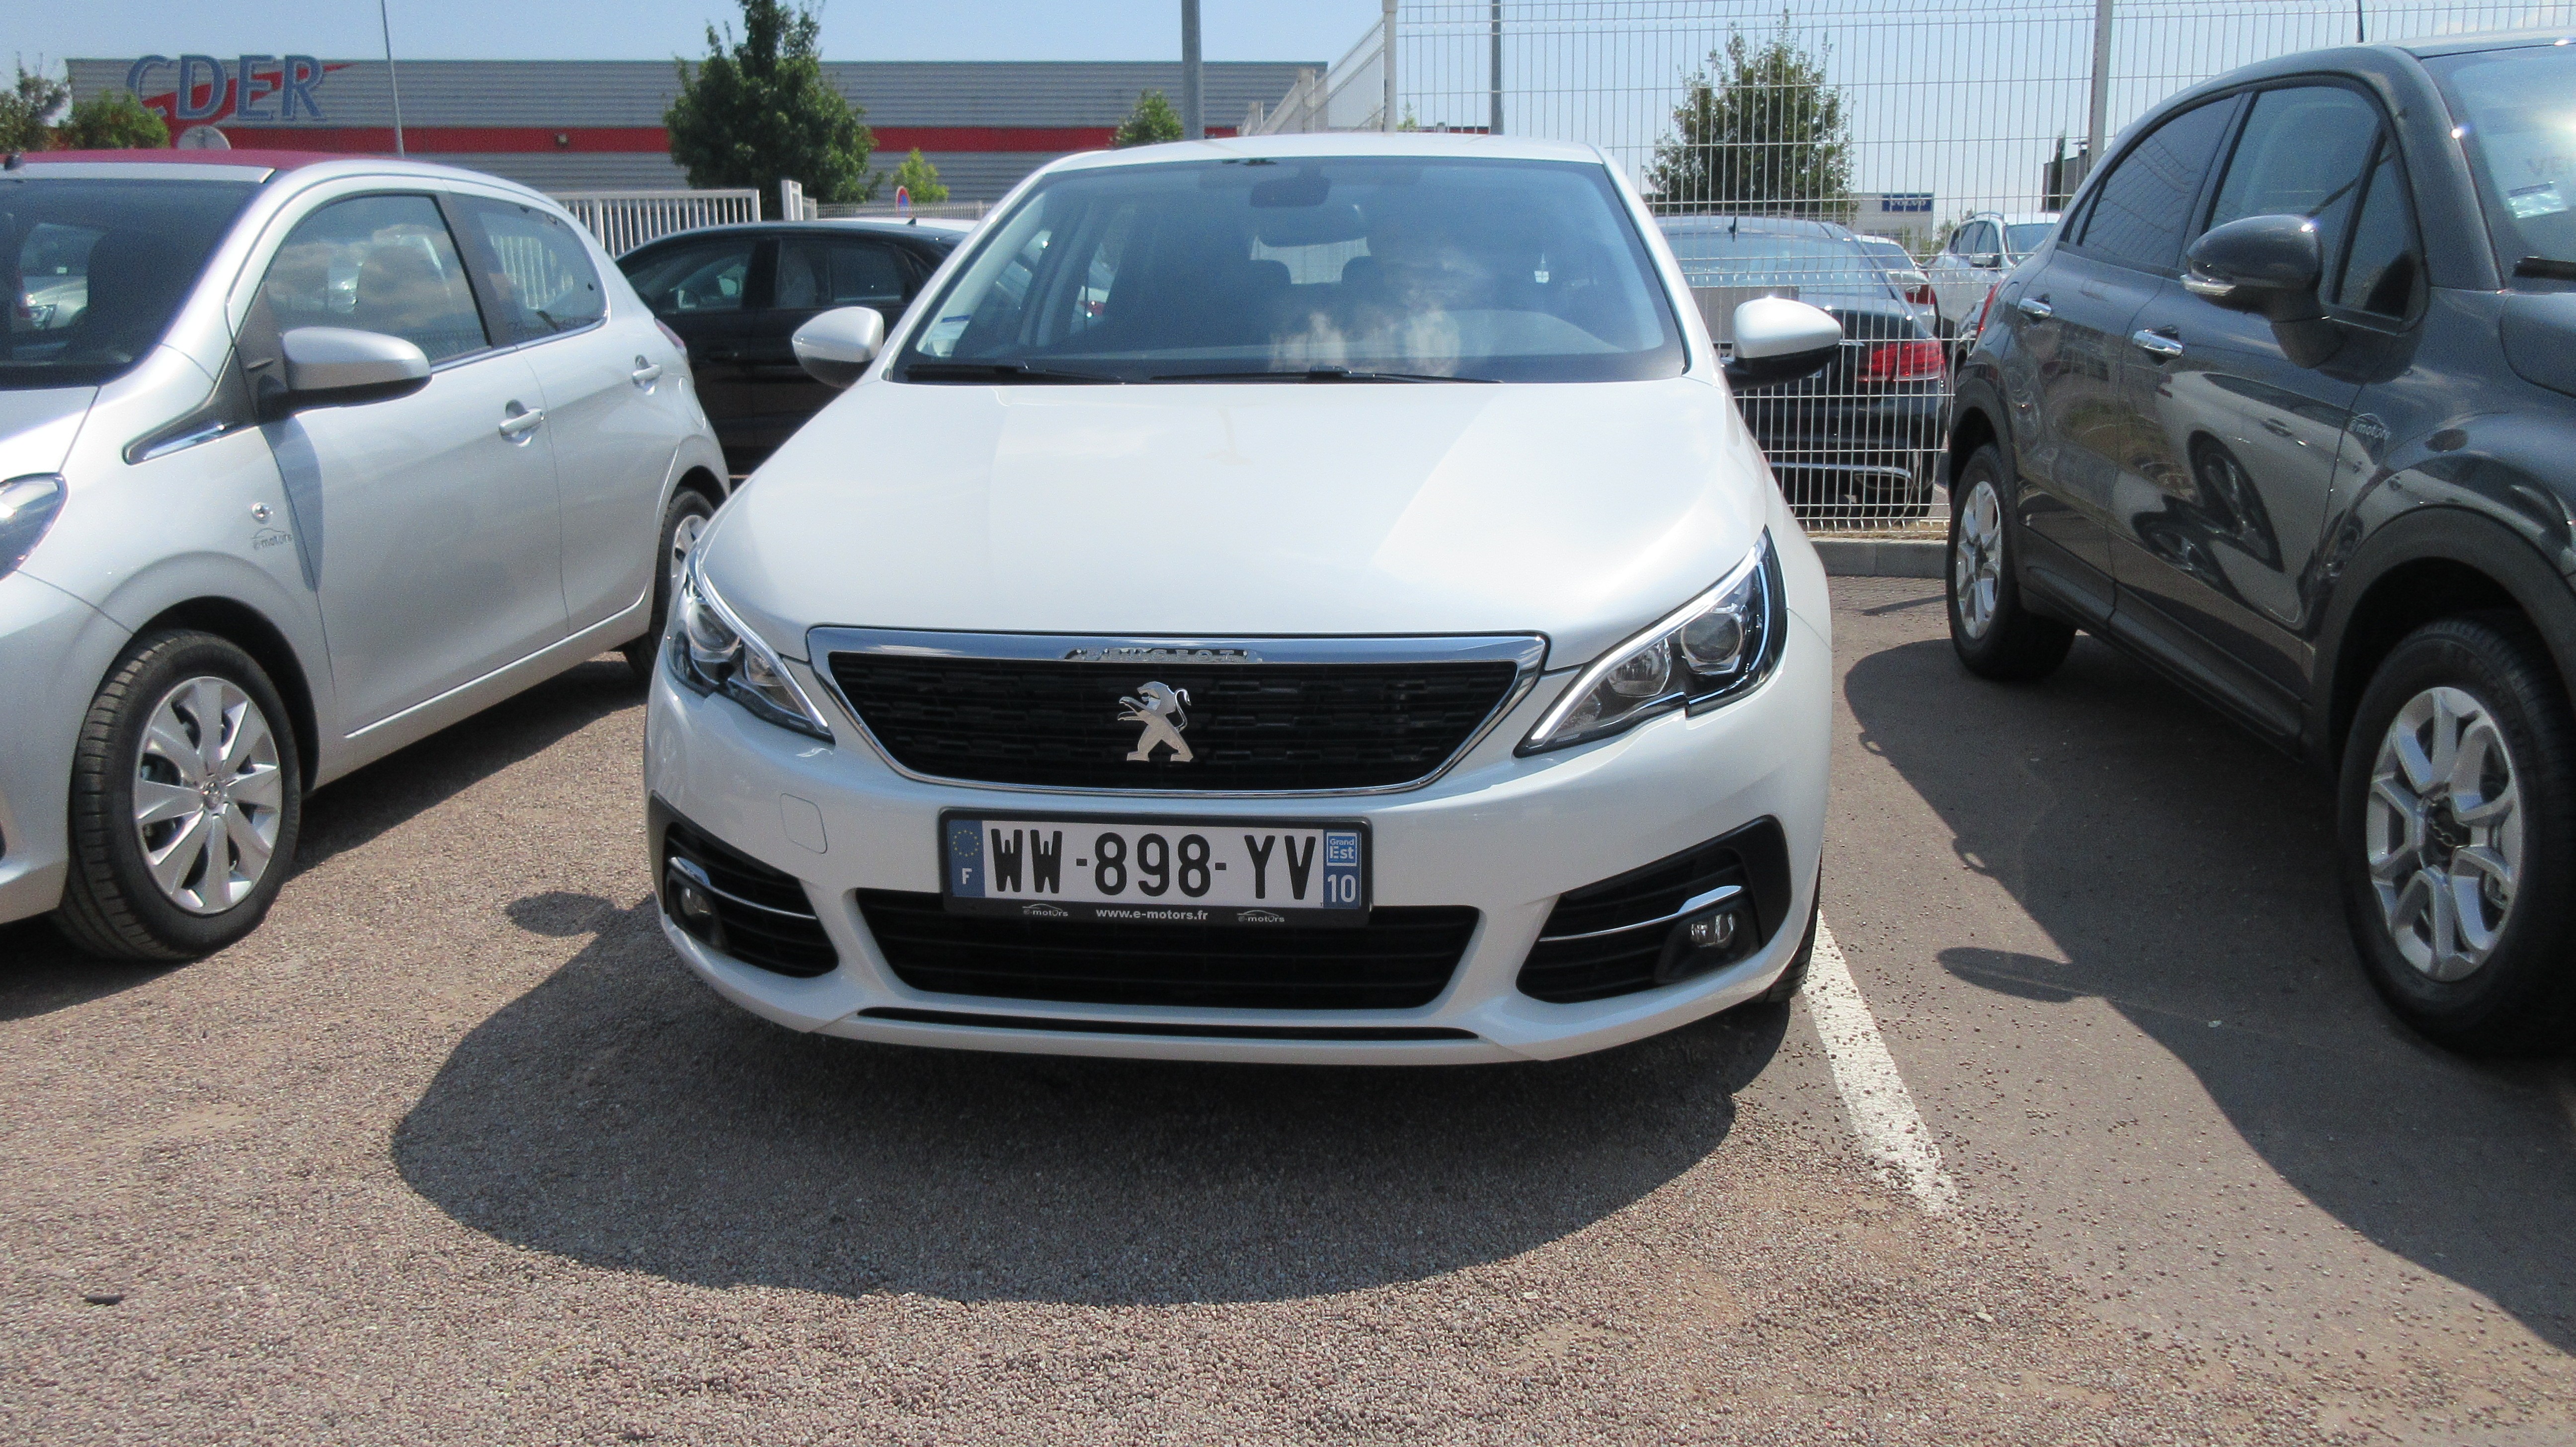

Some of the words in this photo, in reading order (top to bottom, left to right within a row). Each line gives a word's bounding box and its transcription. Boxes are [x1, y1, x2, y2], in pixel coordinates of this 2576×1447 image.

[126, 54, 324, 121] CDER
[991, 828, 1316, 899] WW-898-YV
[1329, 846, 1355, 859] Est
[962, 868, 972, 884] F
[1327, 874, 1356, 902] 10
[1096, 909, 1208, 920] www.e-motors.fr
